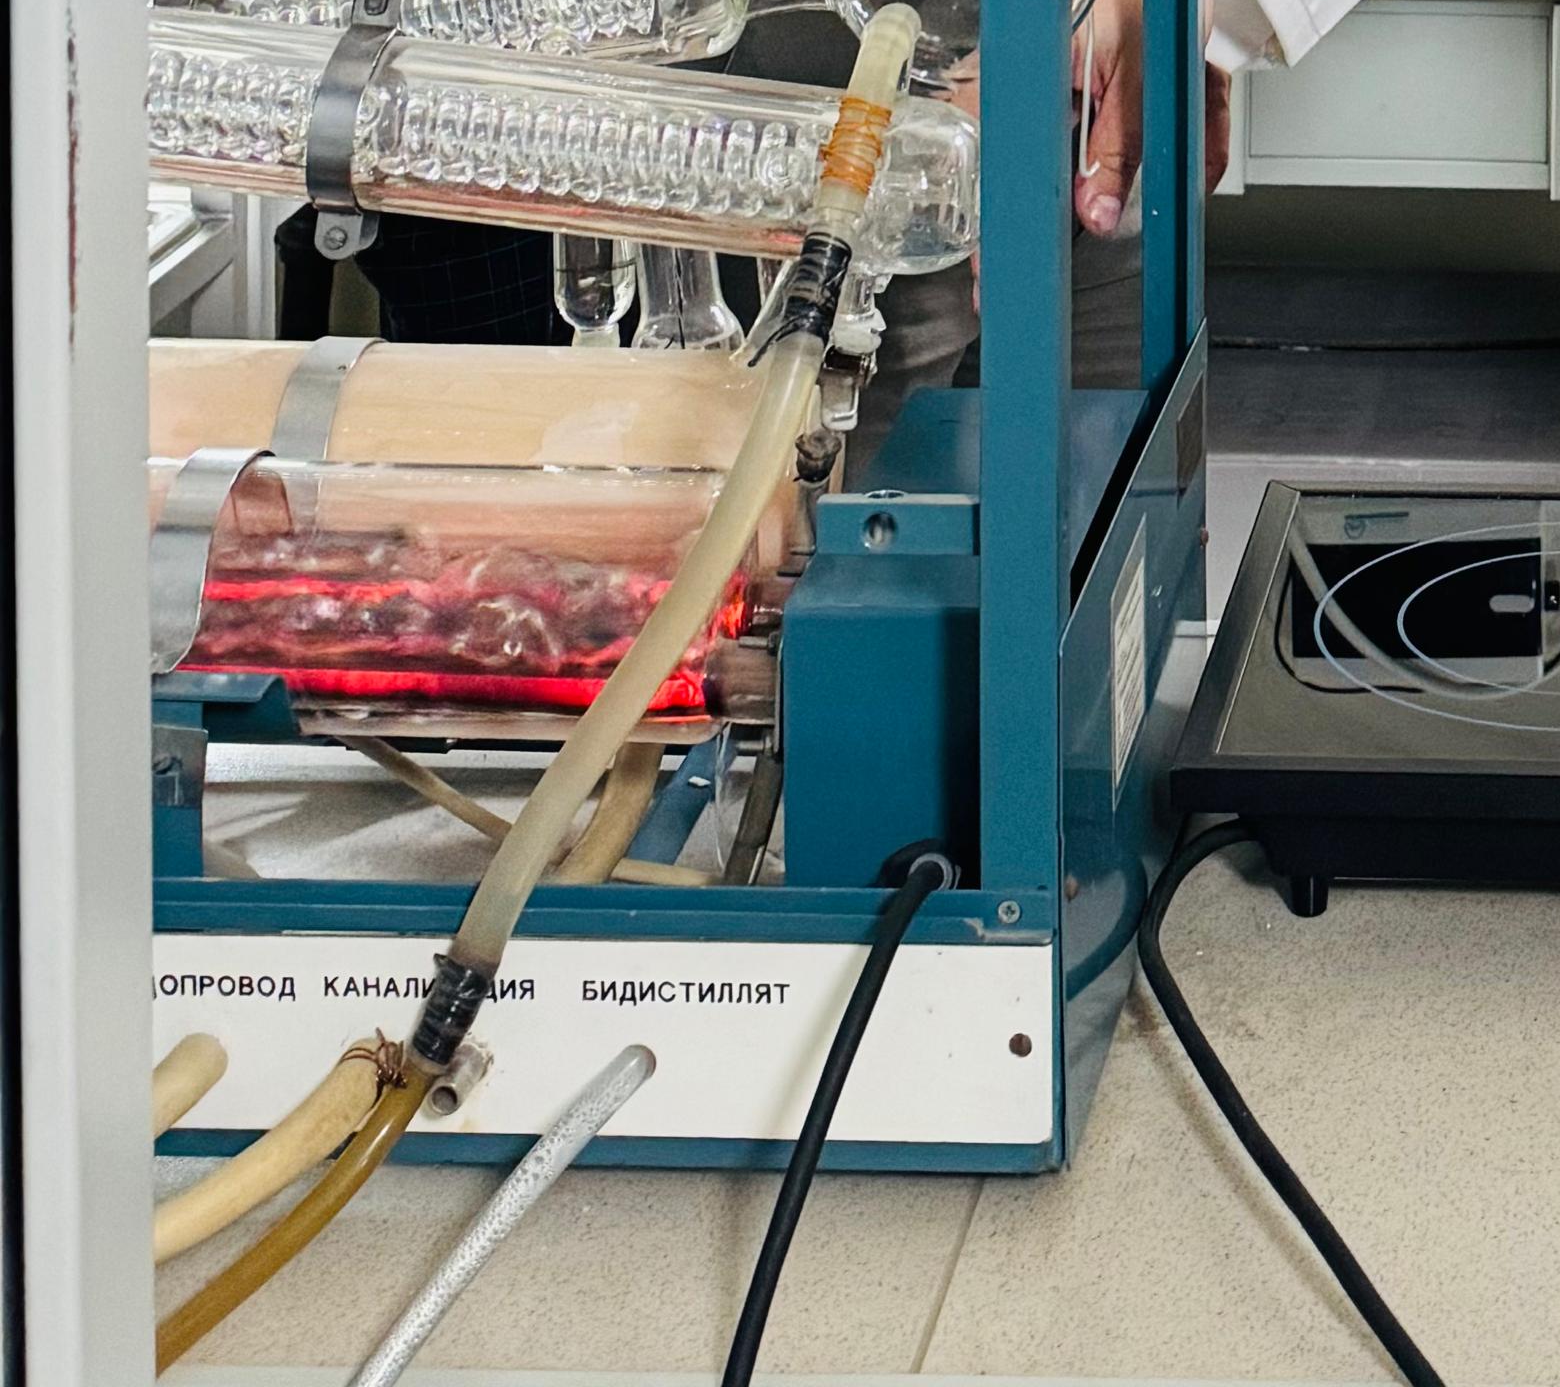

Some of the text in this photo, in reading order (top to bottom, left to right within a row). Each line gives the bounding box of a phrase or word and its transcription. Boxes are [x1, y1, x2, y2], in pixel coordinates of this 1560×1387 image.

[152, 974, 296, 1001] ОПРОВОД
[324, 976, 534, 1002] КАНАЛИИЯ
[582, 980, 790, 1006] БИДИСТИЛЛЯТ
